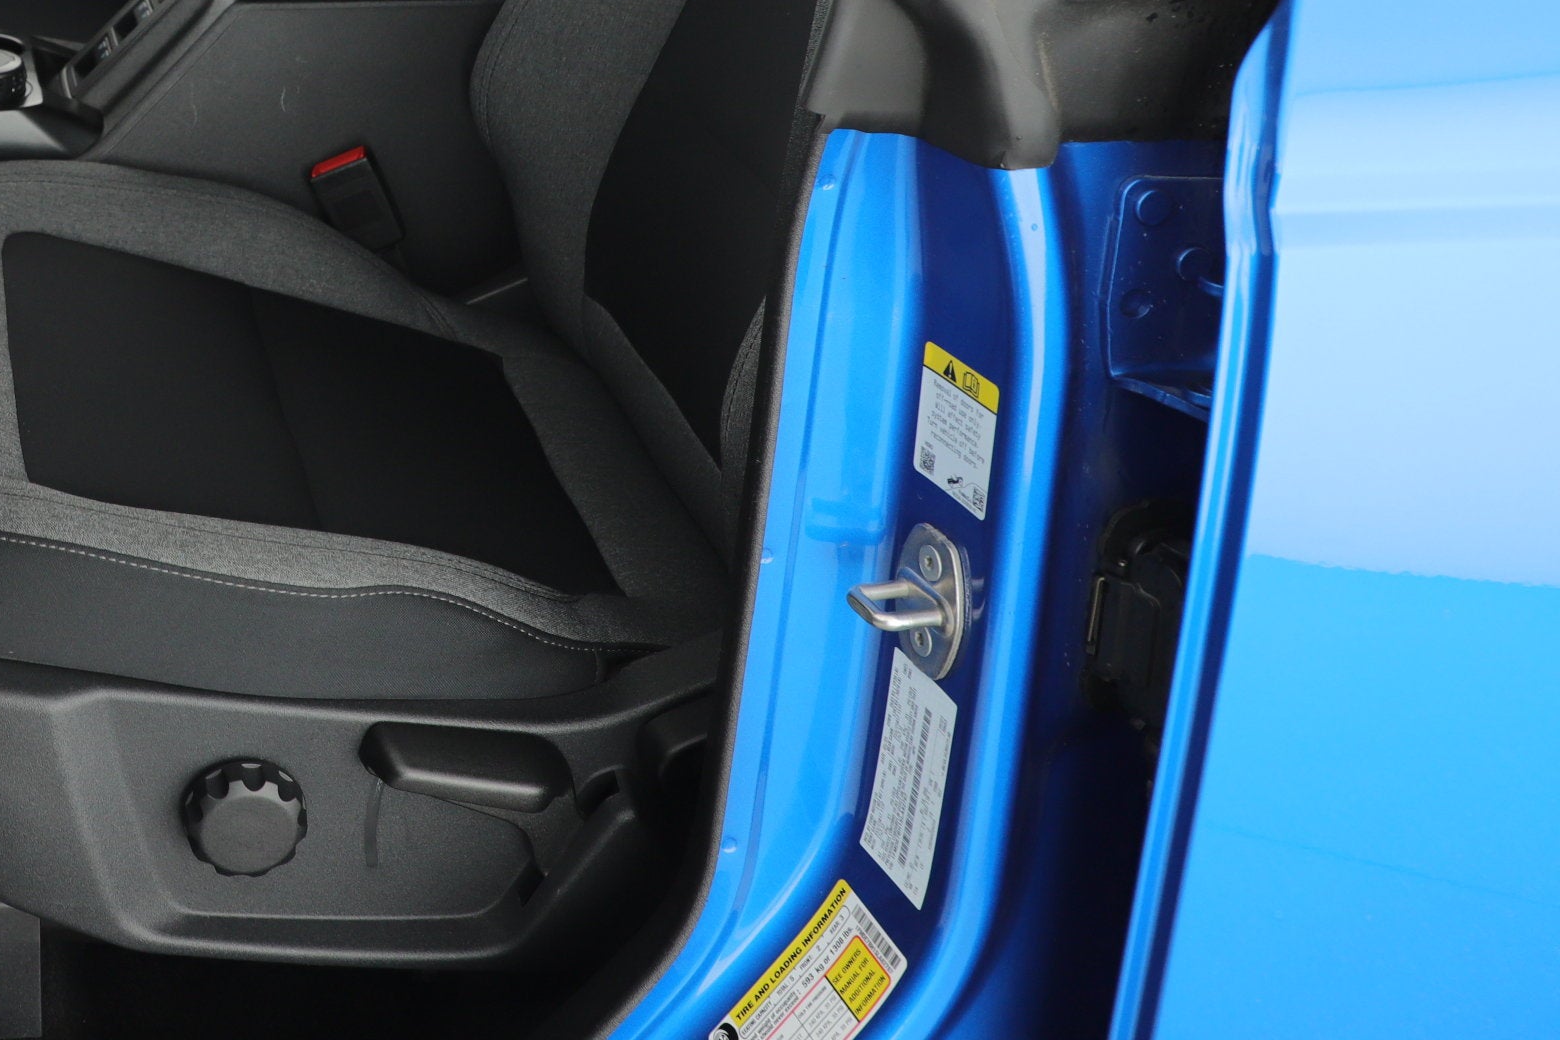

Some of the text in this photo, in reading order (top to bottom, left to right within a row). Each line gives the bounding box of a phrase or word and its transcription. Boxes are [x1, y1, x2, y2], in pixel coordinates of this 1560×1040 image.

[735, 887, 847, 1021] TIRE AND LOADING INFORMATION
[801, 972, 814, 988] 593
[814, 962, 823, 973] kg
[822, 954, 831, 965] or
[828, 936, 844, 955] 1308
[832, 948, 861, 985] SEE OWNERS
[839, 956, 869, 994] MANUAL FOR
[847, 969, 876, 1002] ADDITIONAL
[853, 974, 886, 1014] INFORMATION
